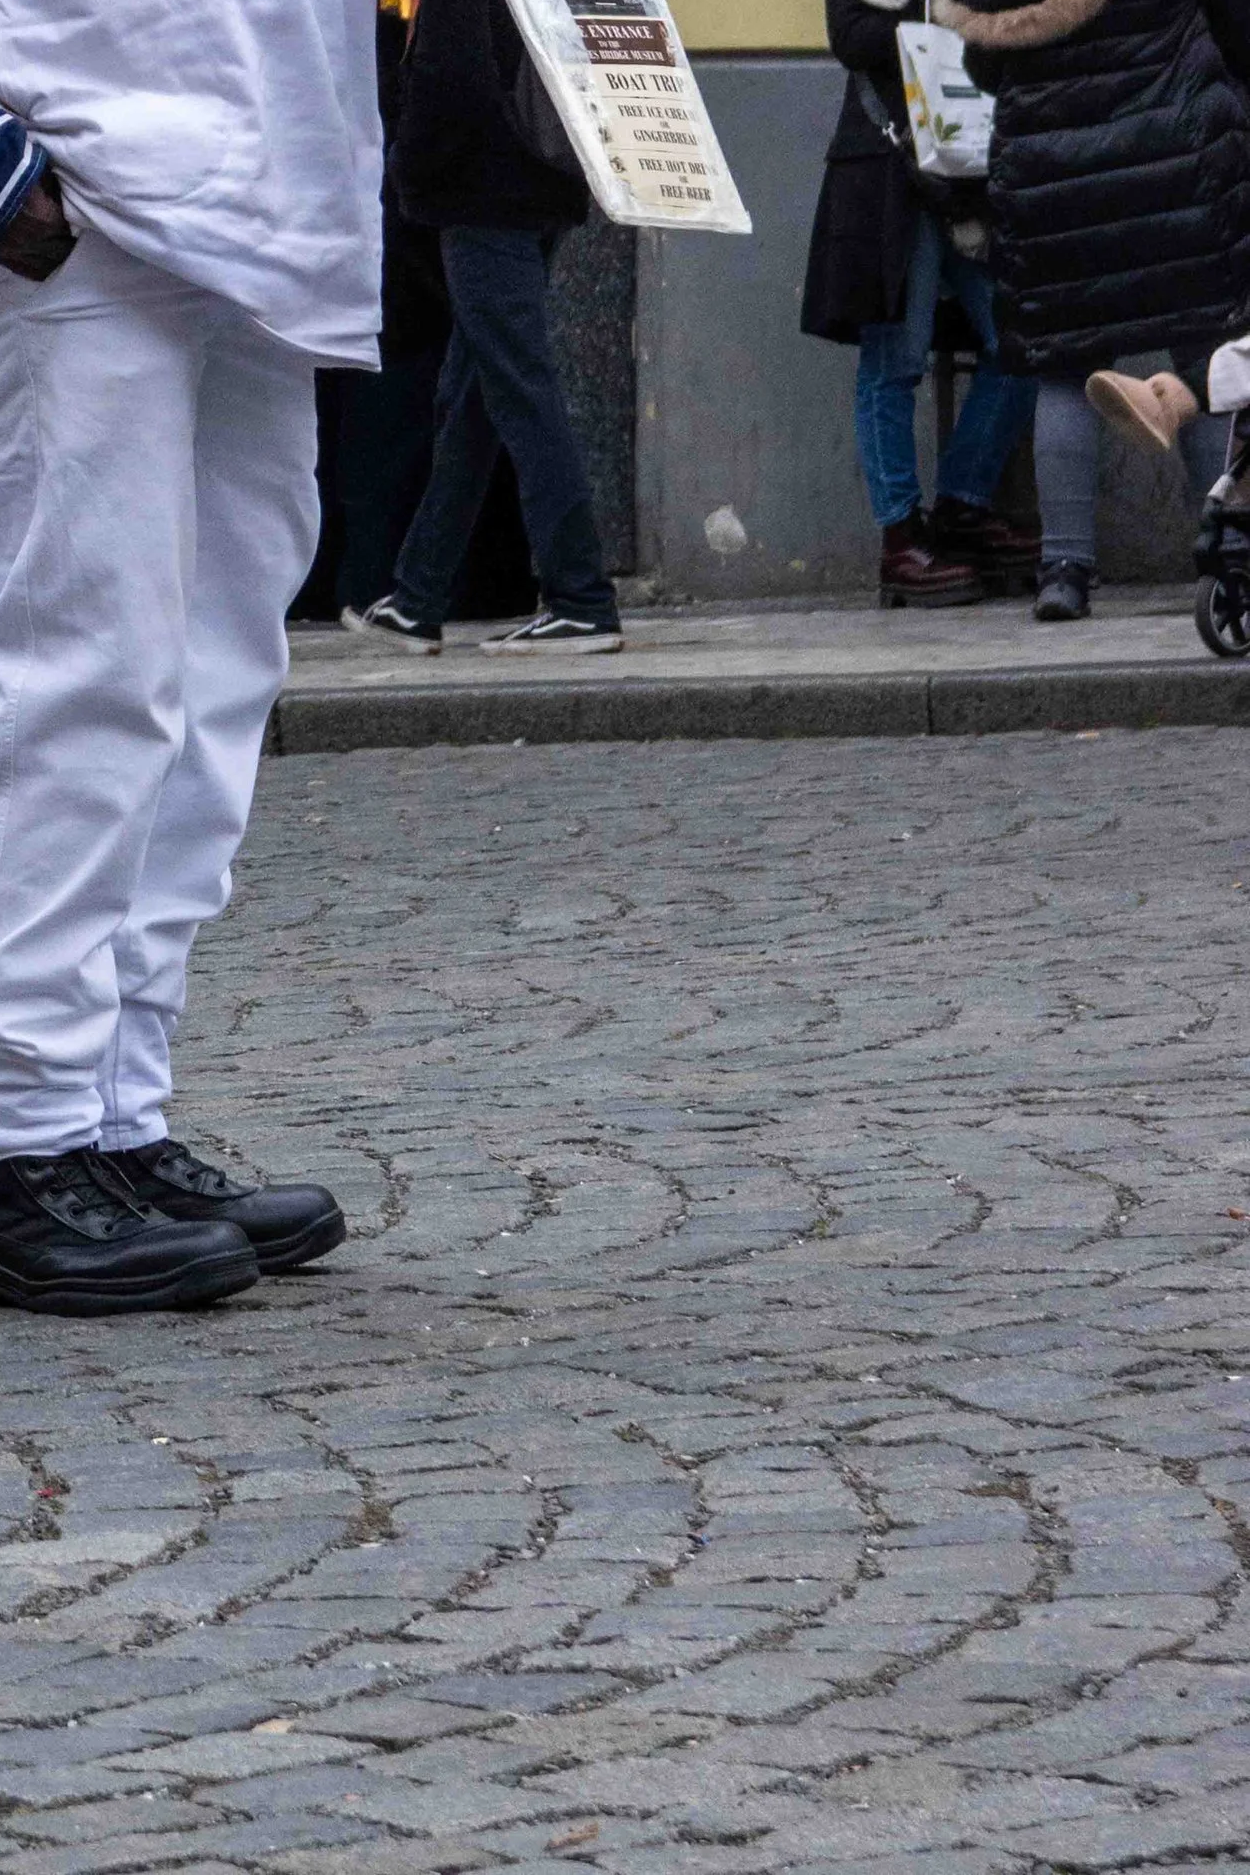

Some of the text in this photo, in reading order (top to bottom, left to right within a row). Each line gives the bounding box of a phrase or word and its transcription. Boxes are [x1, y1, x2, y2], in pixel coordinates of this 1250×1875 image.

[590, 25, 654, 39] ENTRANCE
[600, 50, 631, 60] BRIDGE
[631, 50, 665, 61] MUSEUM
[606, 73, 647, 91] BOAT
[617, 105, 646, 117] FREE
[647, 106, 665, 118] ICE
[638, 158, 718, 176] FREE HOT DRI
[660, 184, 712, 201] FREE BEER
